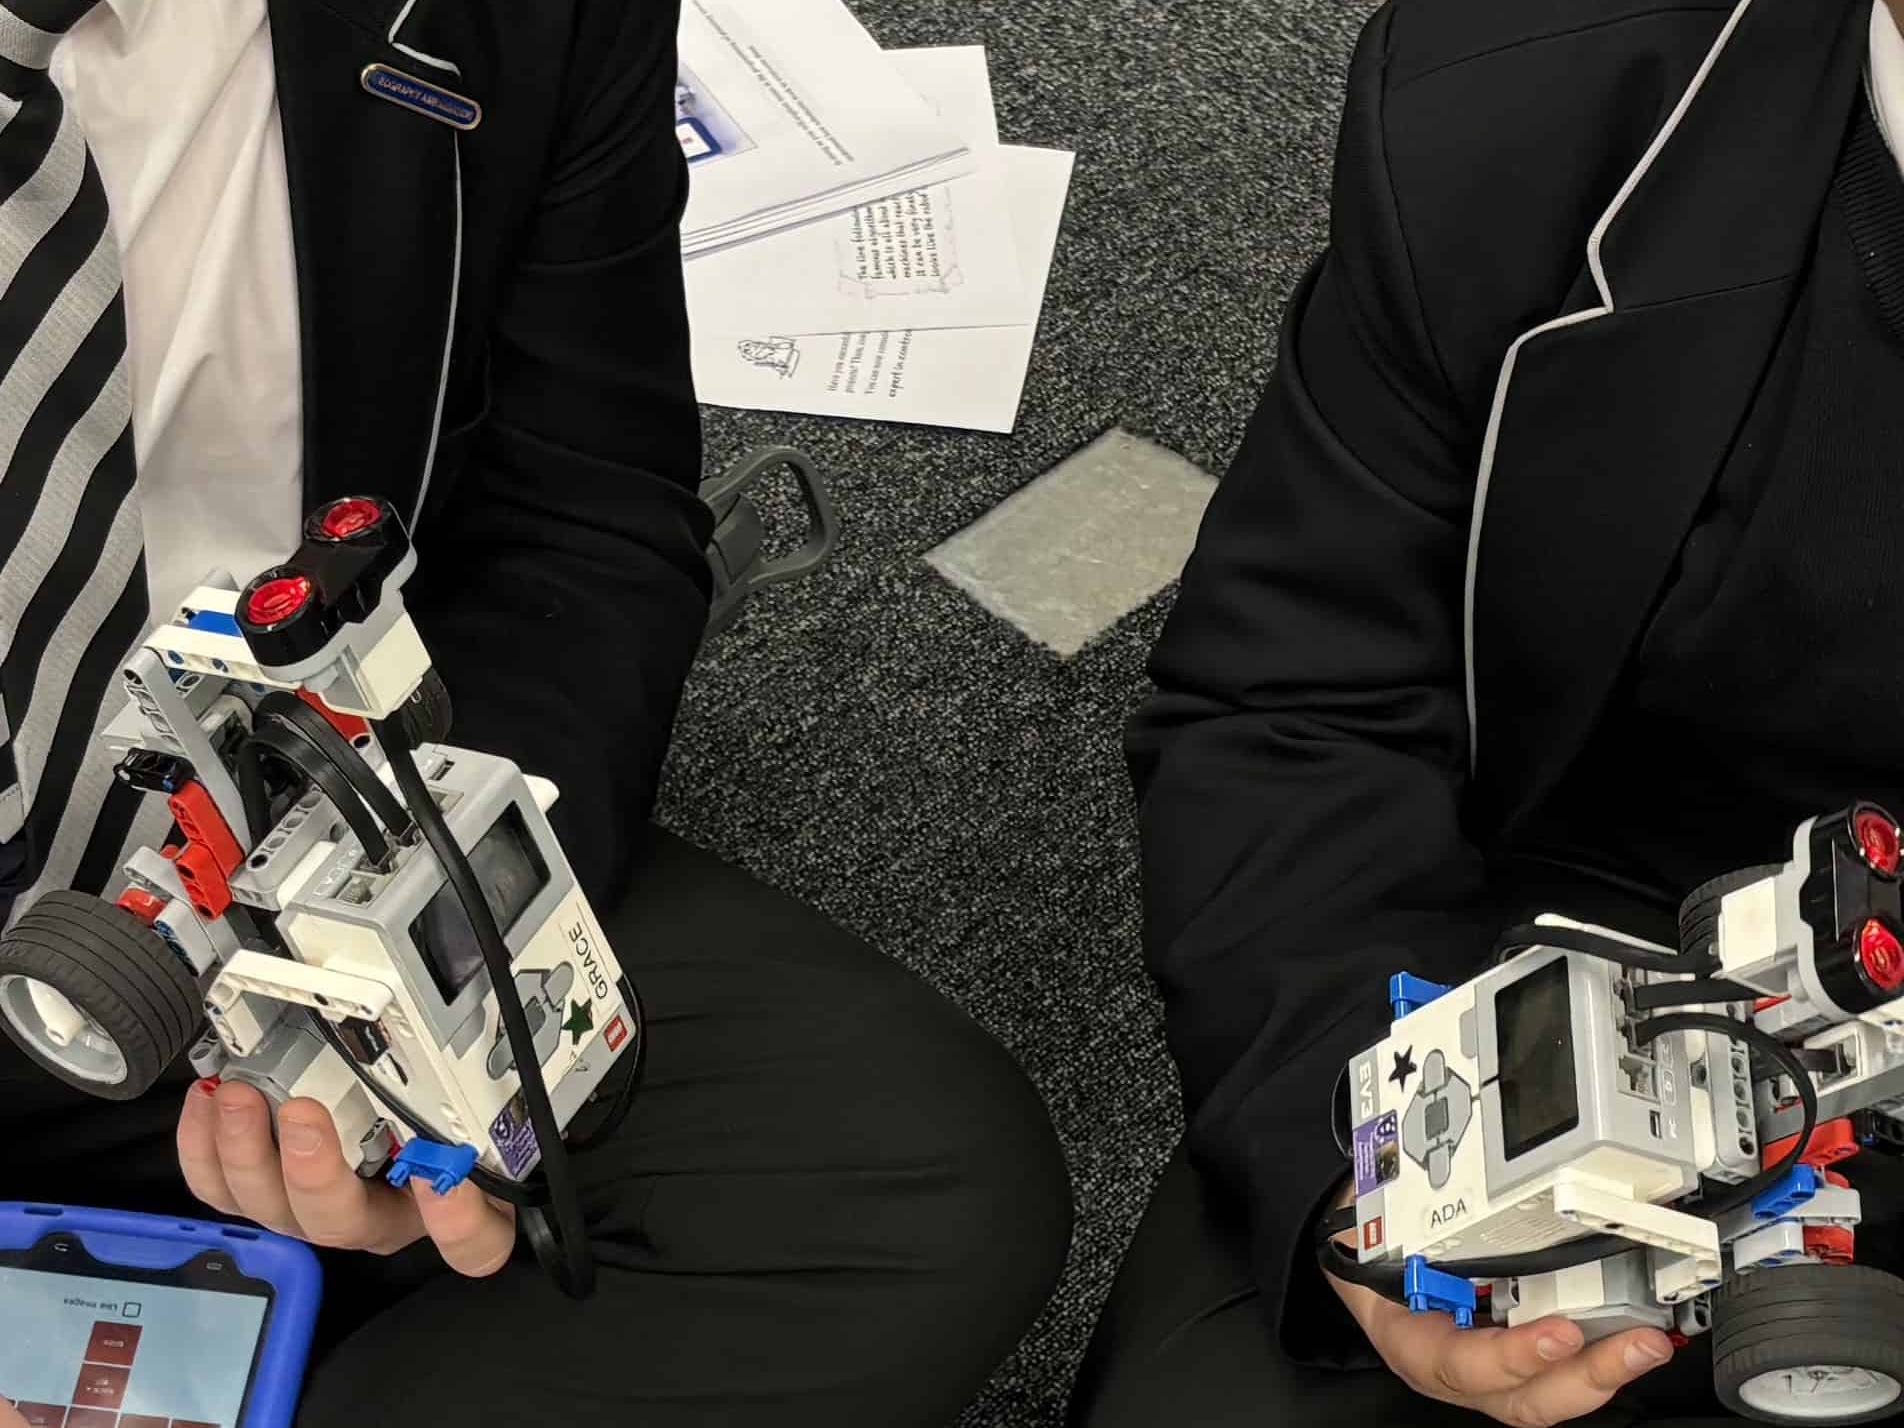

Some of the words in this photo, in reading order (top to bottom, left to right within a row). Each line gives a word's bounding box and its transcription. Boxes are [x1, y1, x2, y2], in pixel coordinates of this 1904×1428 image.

[569, 920, 611, 1001] GRACE
[1358, 1060, 1375, 1120] EV3
[1427, 1197, 1469, 1230] ADA
